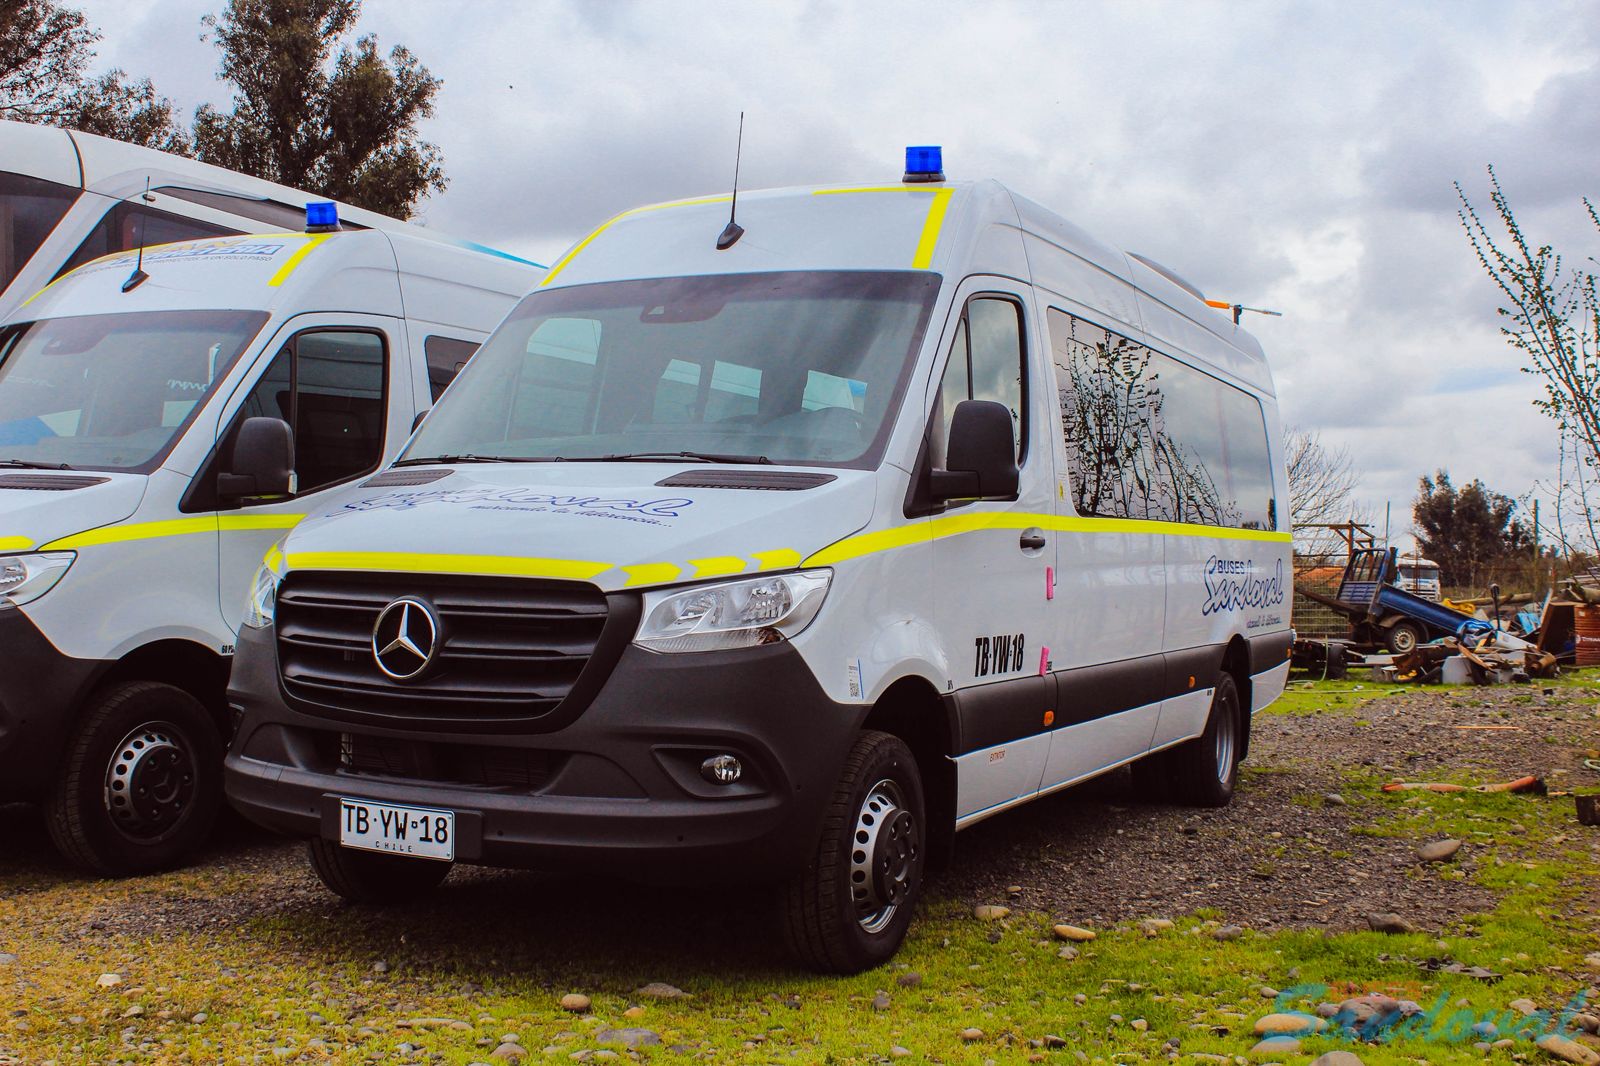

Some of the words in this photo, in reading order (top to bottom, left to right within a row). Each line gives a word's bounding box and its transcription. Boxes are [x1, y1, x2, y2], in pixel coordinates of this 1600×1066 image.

[1217, 559, 1245, 574] BUSES
[1202, 554, 1284, 616] Sandoval
[375, 840, 413, 853] CHILE
